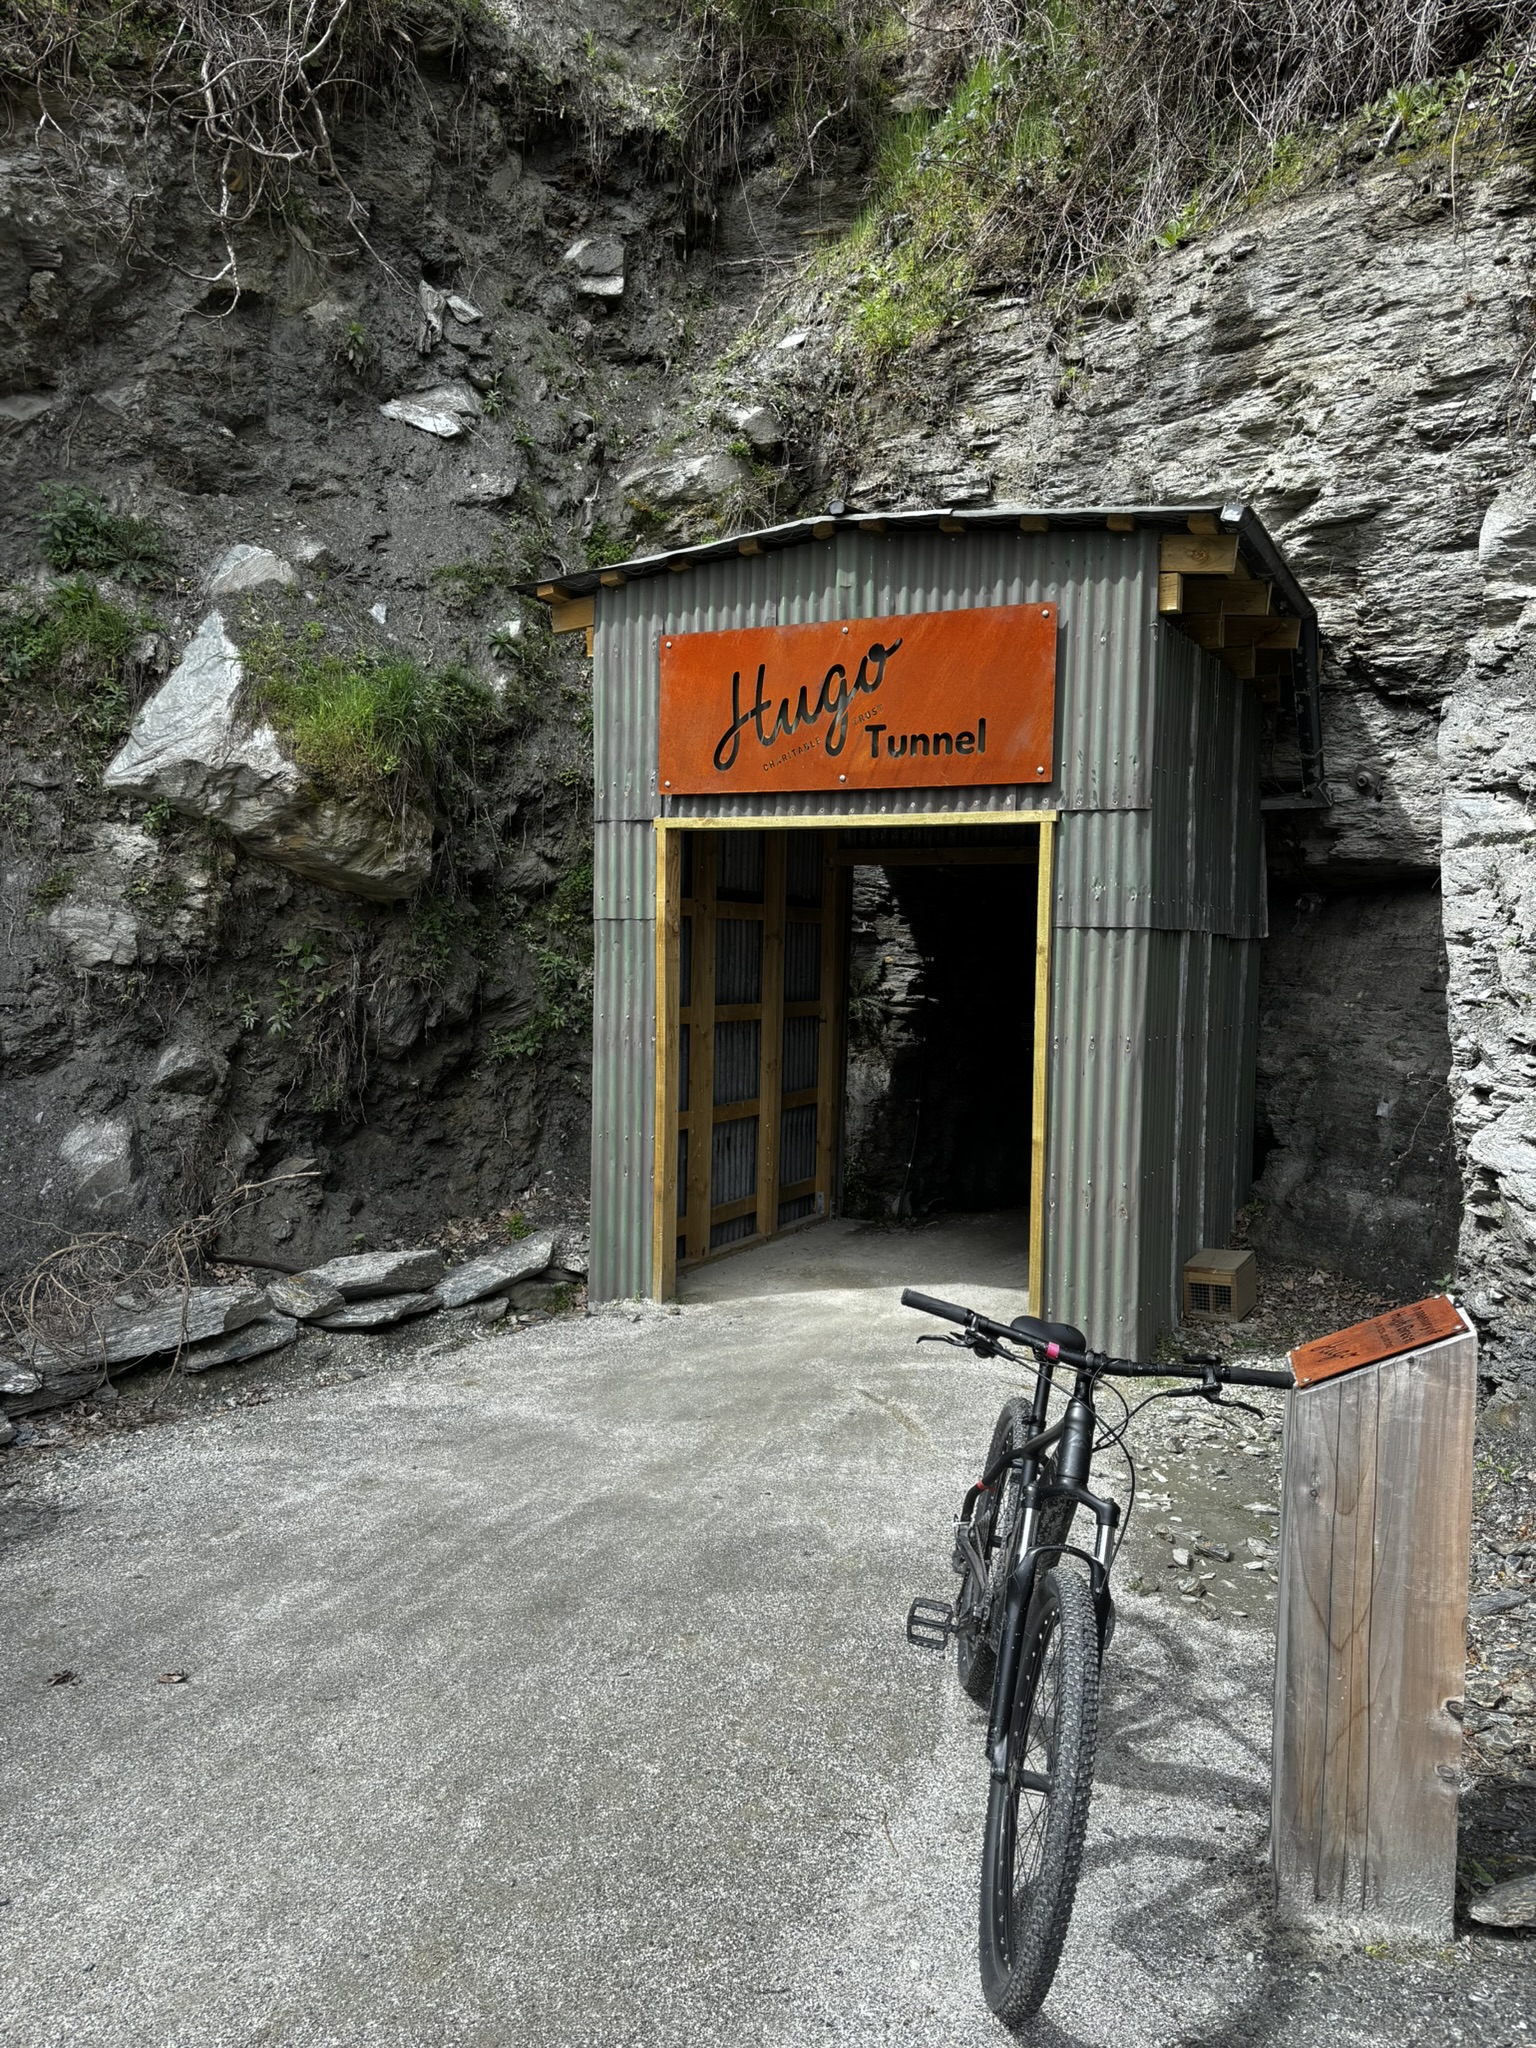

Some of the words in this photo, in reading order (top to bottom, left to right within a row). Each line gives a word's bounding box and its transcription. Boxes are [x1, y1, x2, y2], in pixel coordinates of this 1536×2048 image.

[713, 637, 903, 771] Hugo
[763, 736, 821, 771] CHARITABLE
[851, 703, 883, 725] TRUST
[864, 717, 986, 759] Tunnel
